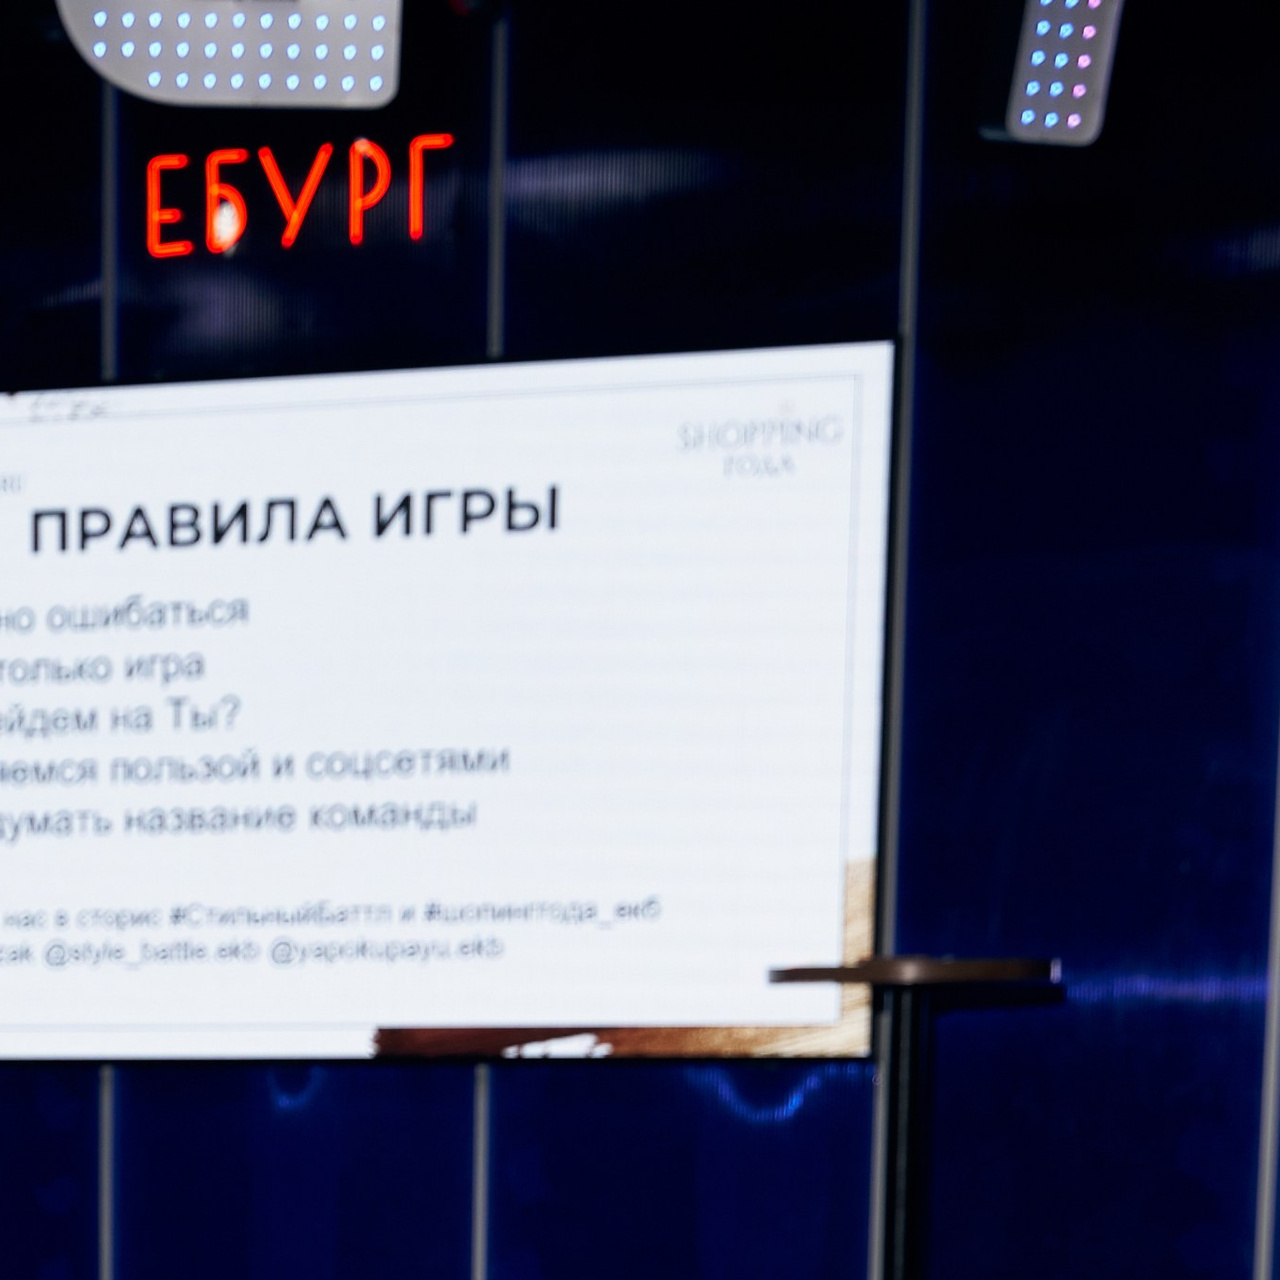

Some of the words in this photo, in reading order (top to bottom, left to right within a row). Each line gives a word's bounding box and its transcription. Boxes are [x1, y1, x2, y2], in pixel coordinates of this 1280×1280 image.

[147, 133, 454, 258] ЕБУРГ
[676, 415, 845, 454] SHOPPING
[31, 496, 347, 551] ПРАВИЛА
[374, 485, 558, 538] ИГРЫ
[46, 594, 249, 633] ошибаться
[124, 653, 205, 686] игра
[110, 705, 153, 733] на
[167, 694, 241, 732] Ты?
[110, 748, 260, 783] пользой
[273, 755, 294, 778] и
[306, 749, 510, 780] соцсетями
[124, 805, 297, 835] название
[309, 802, 477, 831] команды
[3, 912, 45, 929] нас
[54, 910, 69, 928] в
[76, 909, 160, 931] сторис
[400, 906, 416, 922] и
